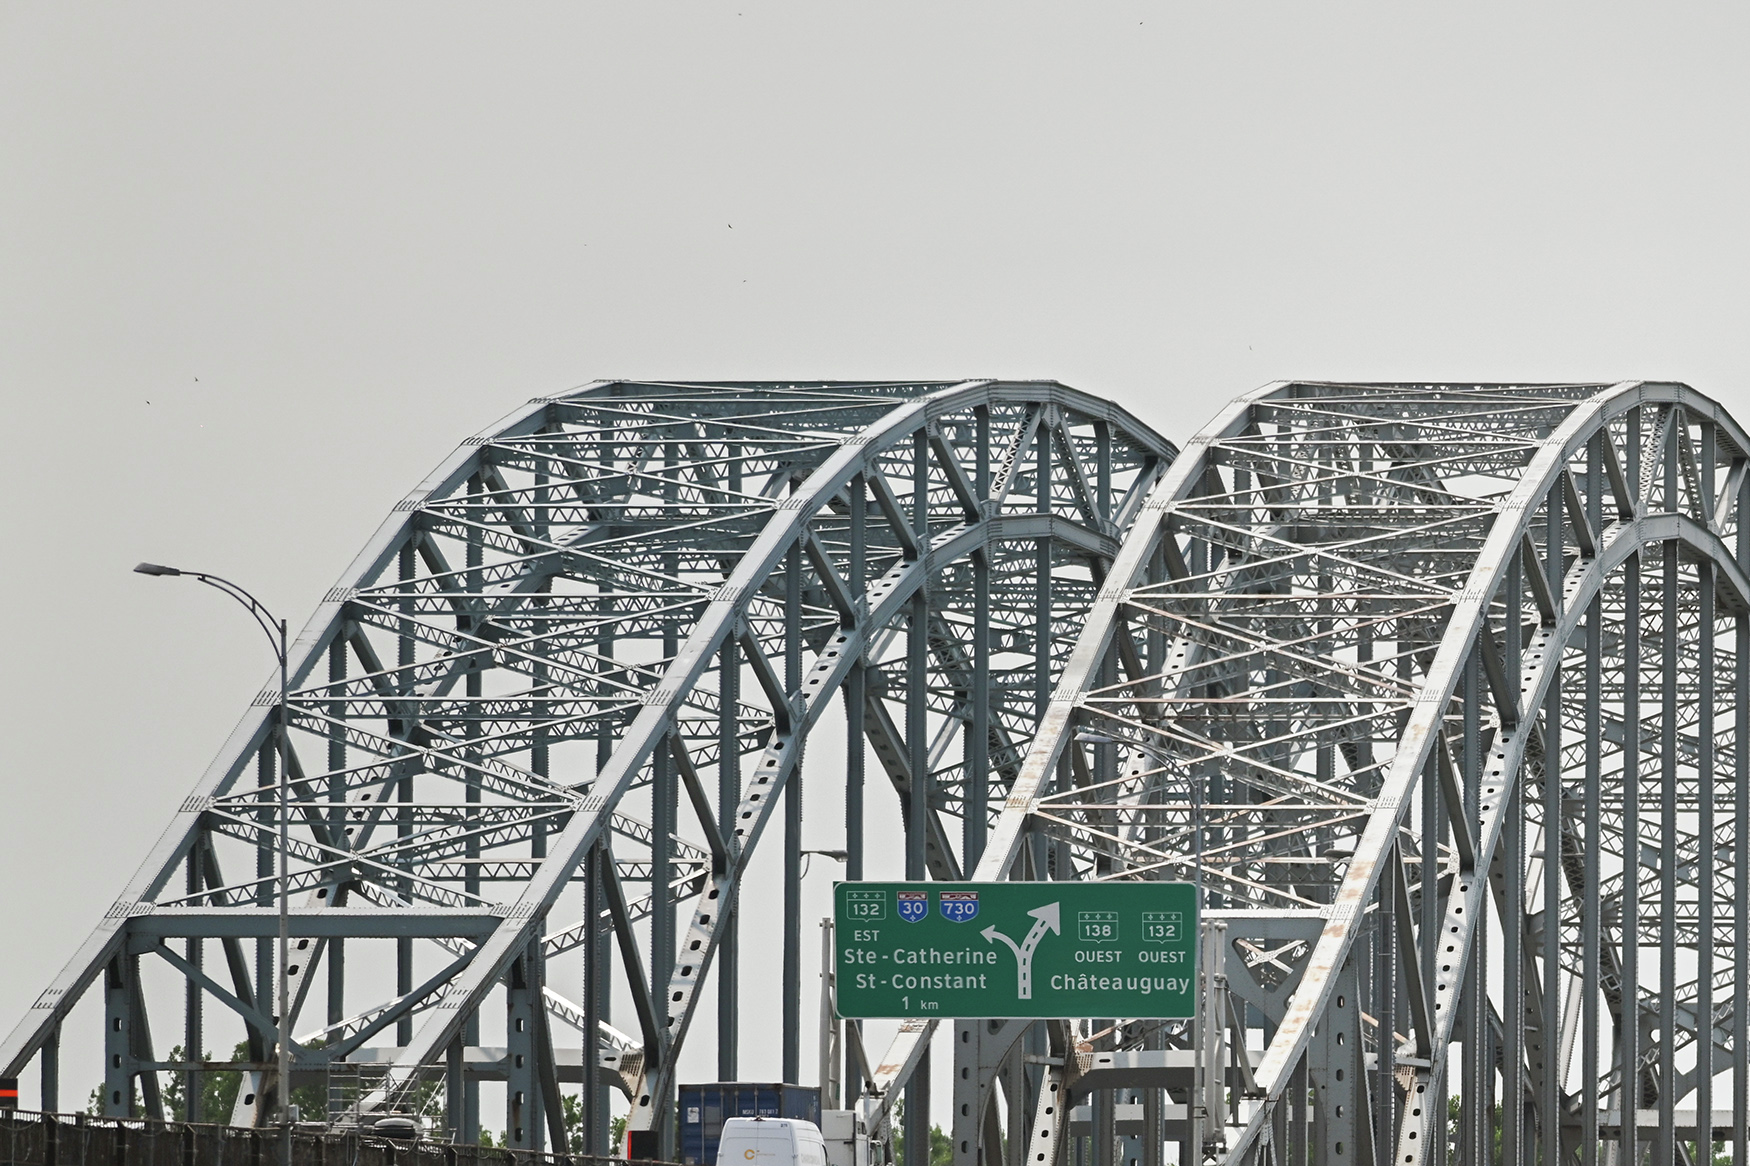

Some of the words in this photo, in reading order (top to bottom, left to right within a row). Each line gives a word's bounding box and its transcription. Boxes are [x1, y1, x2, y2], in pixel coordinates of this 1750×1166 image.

[853, 904, 879, 915] 132
[902, 902, 923, 914] 30
[944, 902, 975, 914] 730
[854, 930, 880, 941] EST
[1085, 925, 1111, 937] 138
[1149, 925, 1176, 937] 132
[1074, 951, 1122, 963] OUEST
[1138, 951, 1186, 963] OUEST
[1050, 974, 1190, 995] Châteauguay
[901, 996, 909, 1009] 1
[920, 1000, 939, 1010] km
